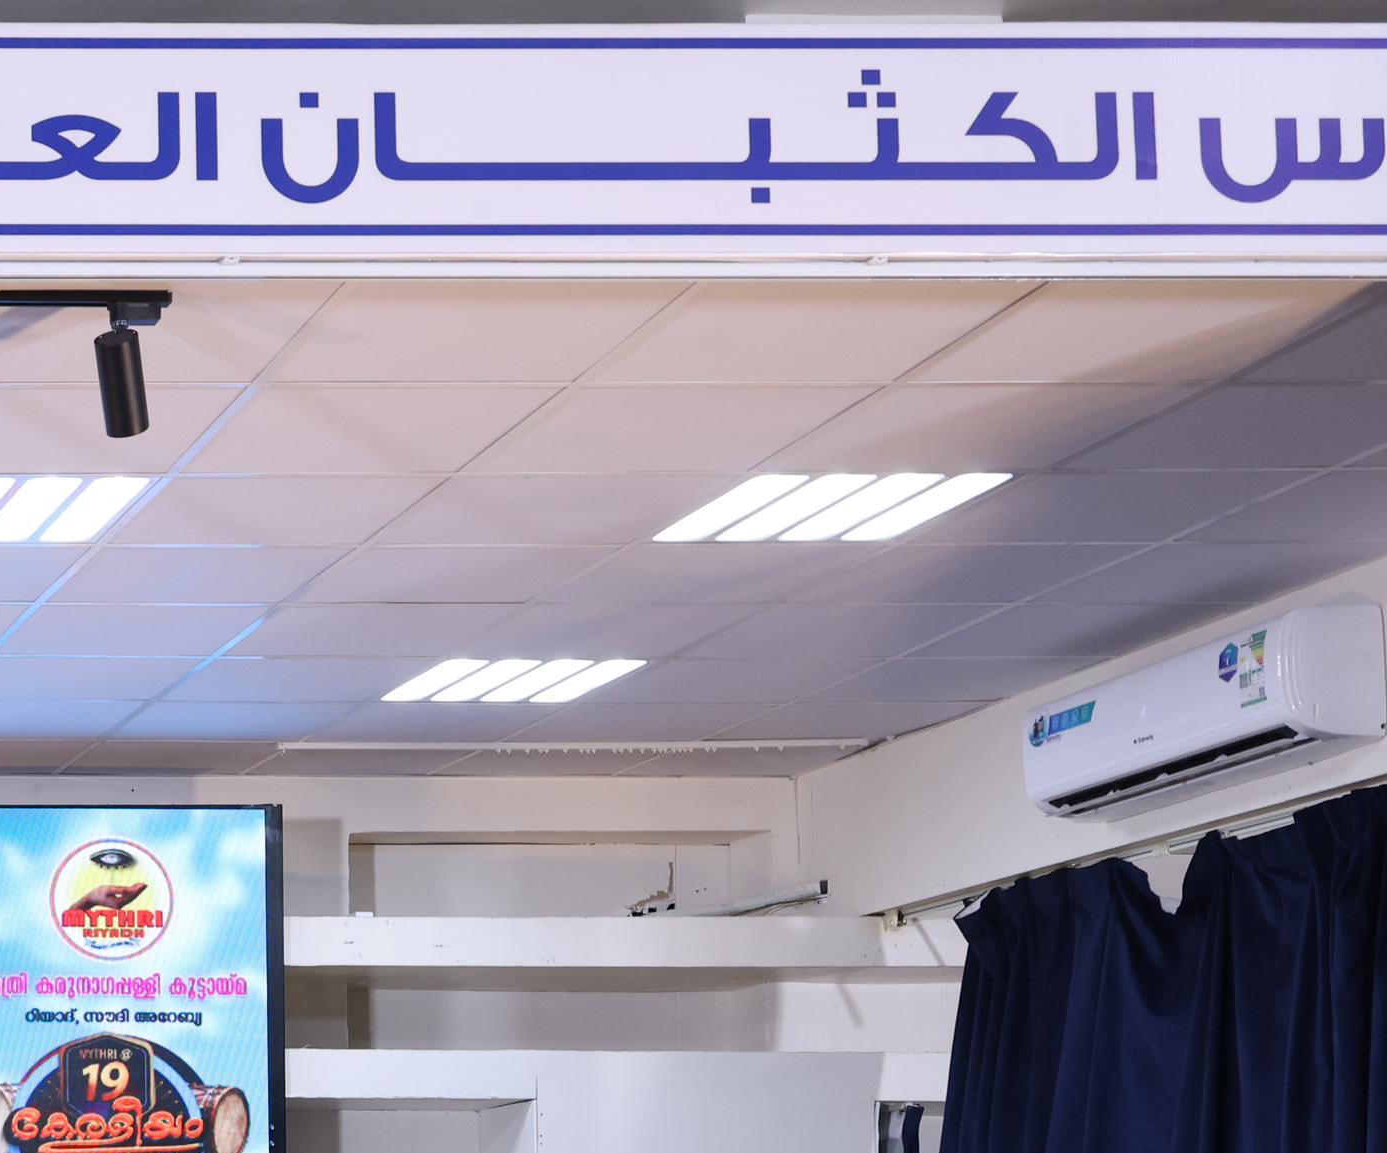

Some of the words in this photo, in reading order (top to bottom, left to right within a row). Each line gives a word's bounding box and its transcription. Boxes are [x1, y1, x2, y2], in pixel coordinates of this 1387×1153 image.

[261, 69, 1158, 205] الكثبان
[62, 909, 163, 928] MYTHRI
[79, 1049, 117, 1060] MYTHRI
[82, 1061, 131, 1102] 19
